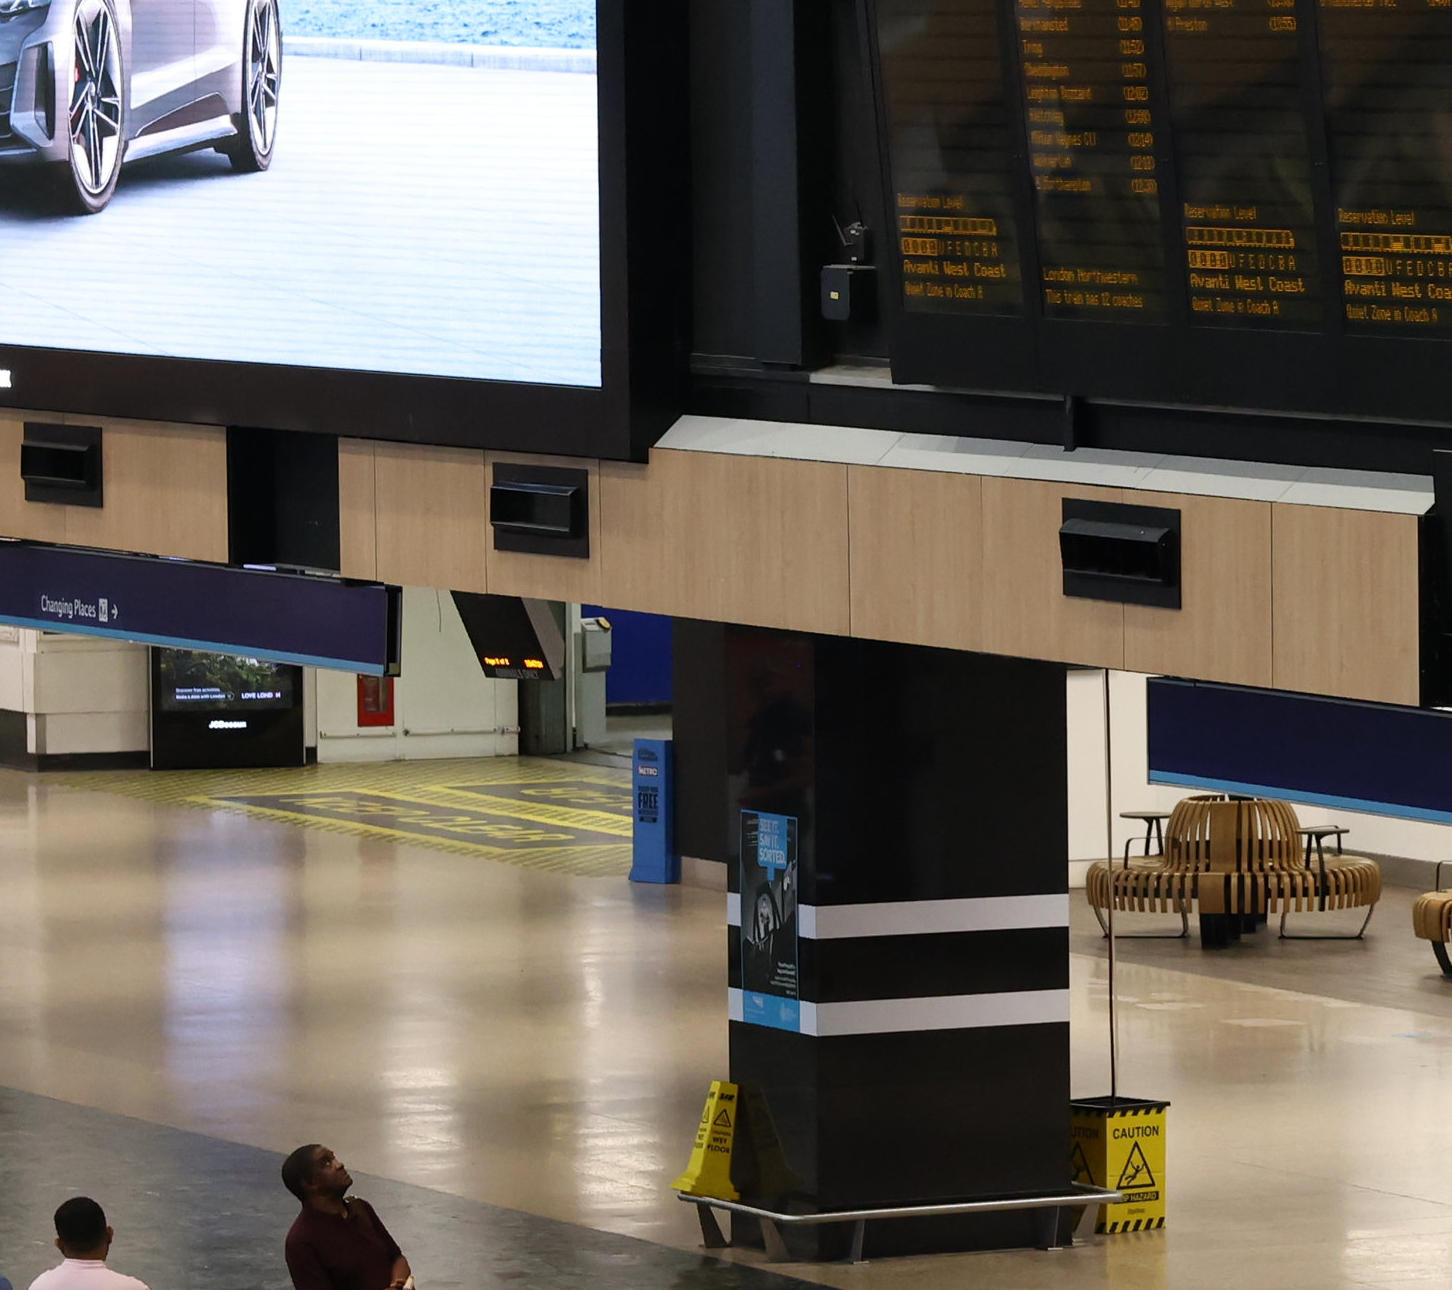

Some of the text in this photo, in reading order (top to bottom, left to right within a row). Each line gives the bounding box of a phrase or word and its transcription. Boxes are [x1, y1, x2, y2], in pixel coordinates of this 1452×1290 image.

[41, 595, 96, 619] Changing Places
[209, 720, 247, 729] JCDecaux
[1113, 1126, 1159, 1139] CAUTION
[708, 1145, 730, 1153] FLOOR
[1131, 1192, 1156, 1201] HAZARD
